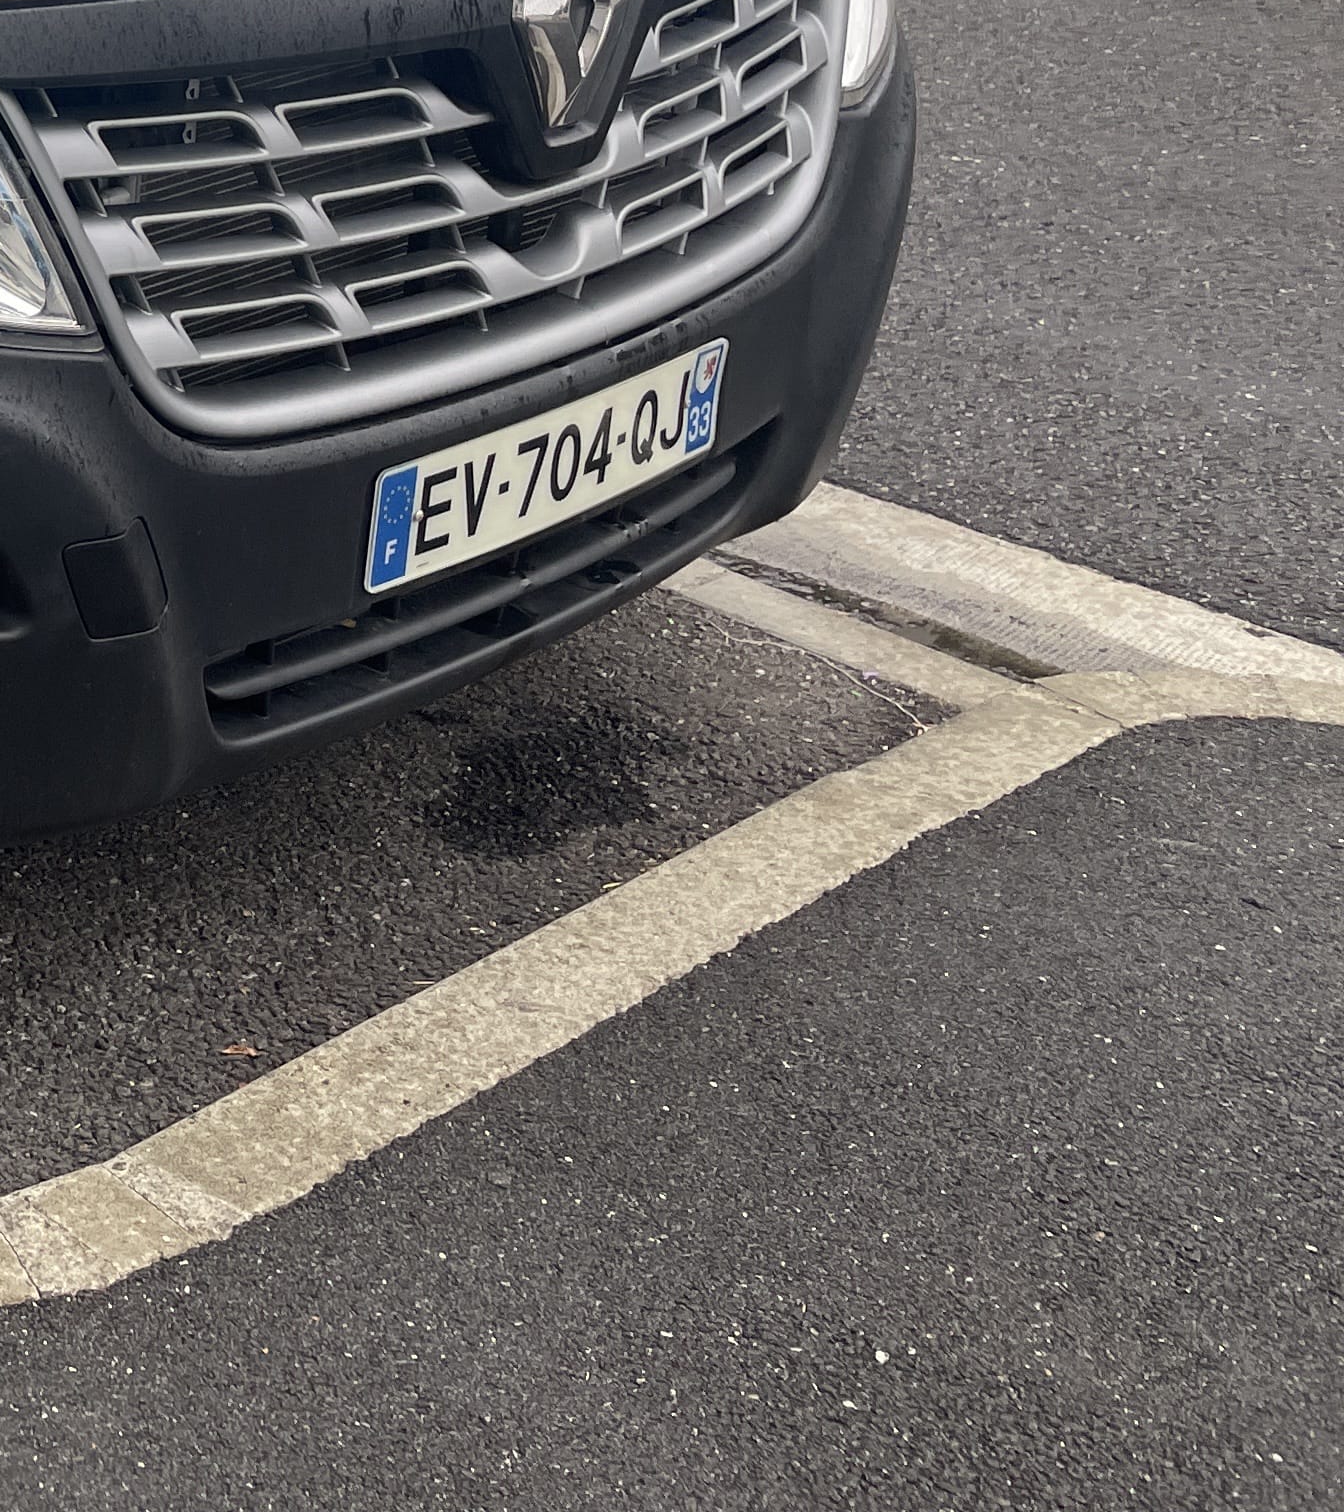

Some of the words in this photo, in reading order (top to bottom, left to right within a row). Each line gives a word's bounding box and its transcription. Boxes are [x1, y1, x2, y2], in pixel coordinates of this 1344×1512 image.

[688, 401, 711, 442] 33
[415, 370, 691, 555] EV-704-QJ
[384, 539, 398, 565] F
